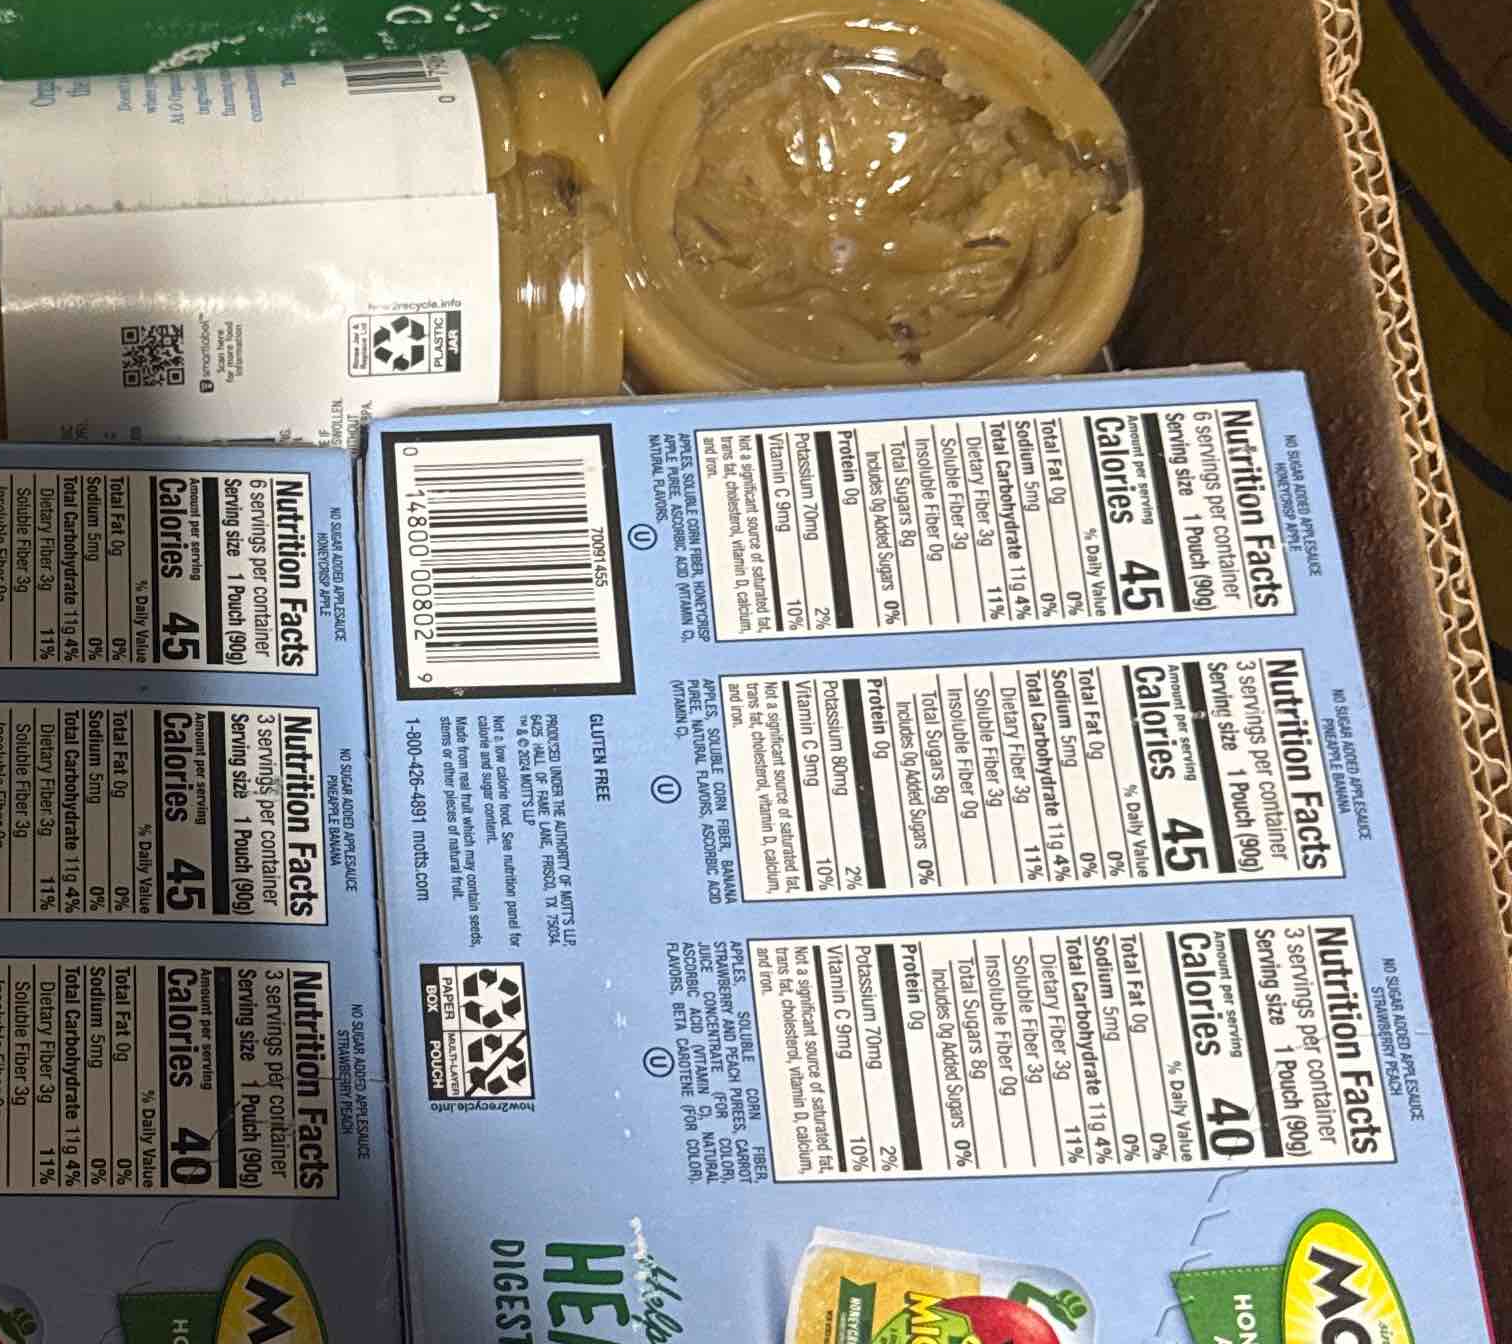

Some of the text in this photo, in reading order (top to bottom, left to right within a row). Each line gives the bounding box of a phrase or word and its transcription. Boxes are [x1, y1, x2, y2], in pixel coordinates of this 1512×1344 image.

[434, 317, 445, 368] PLASTIC
[158, 477, 200, 661] Calories 45
[276, 479, 307, 668] Nutrition Facts
[1093, 415, 1161, 611] Calories 45
[1192, 410, 1242, 599] 6 servings per container
[1221, 408, 1284, 609] Nutrition Facts
[404, 717, 432, 902] 1-800-426-4891 motts.com
[1178, 931, 1256, 1156] Calories 40
[1314, 924, 1381, 1156] Nutrition Facts
